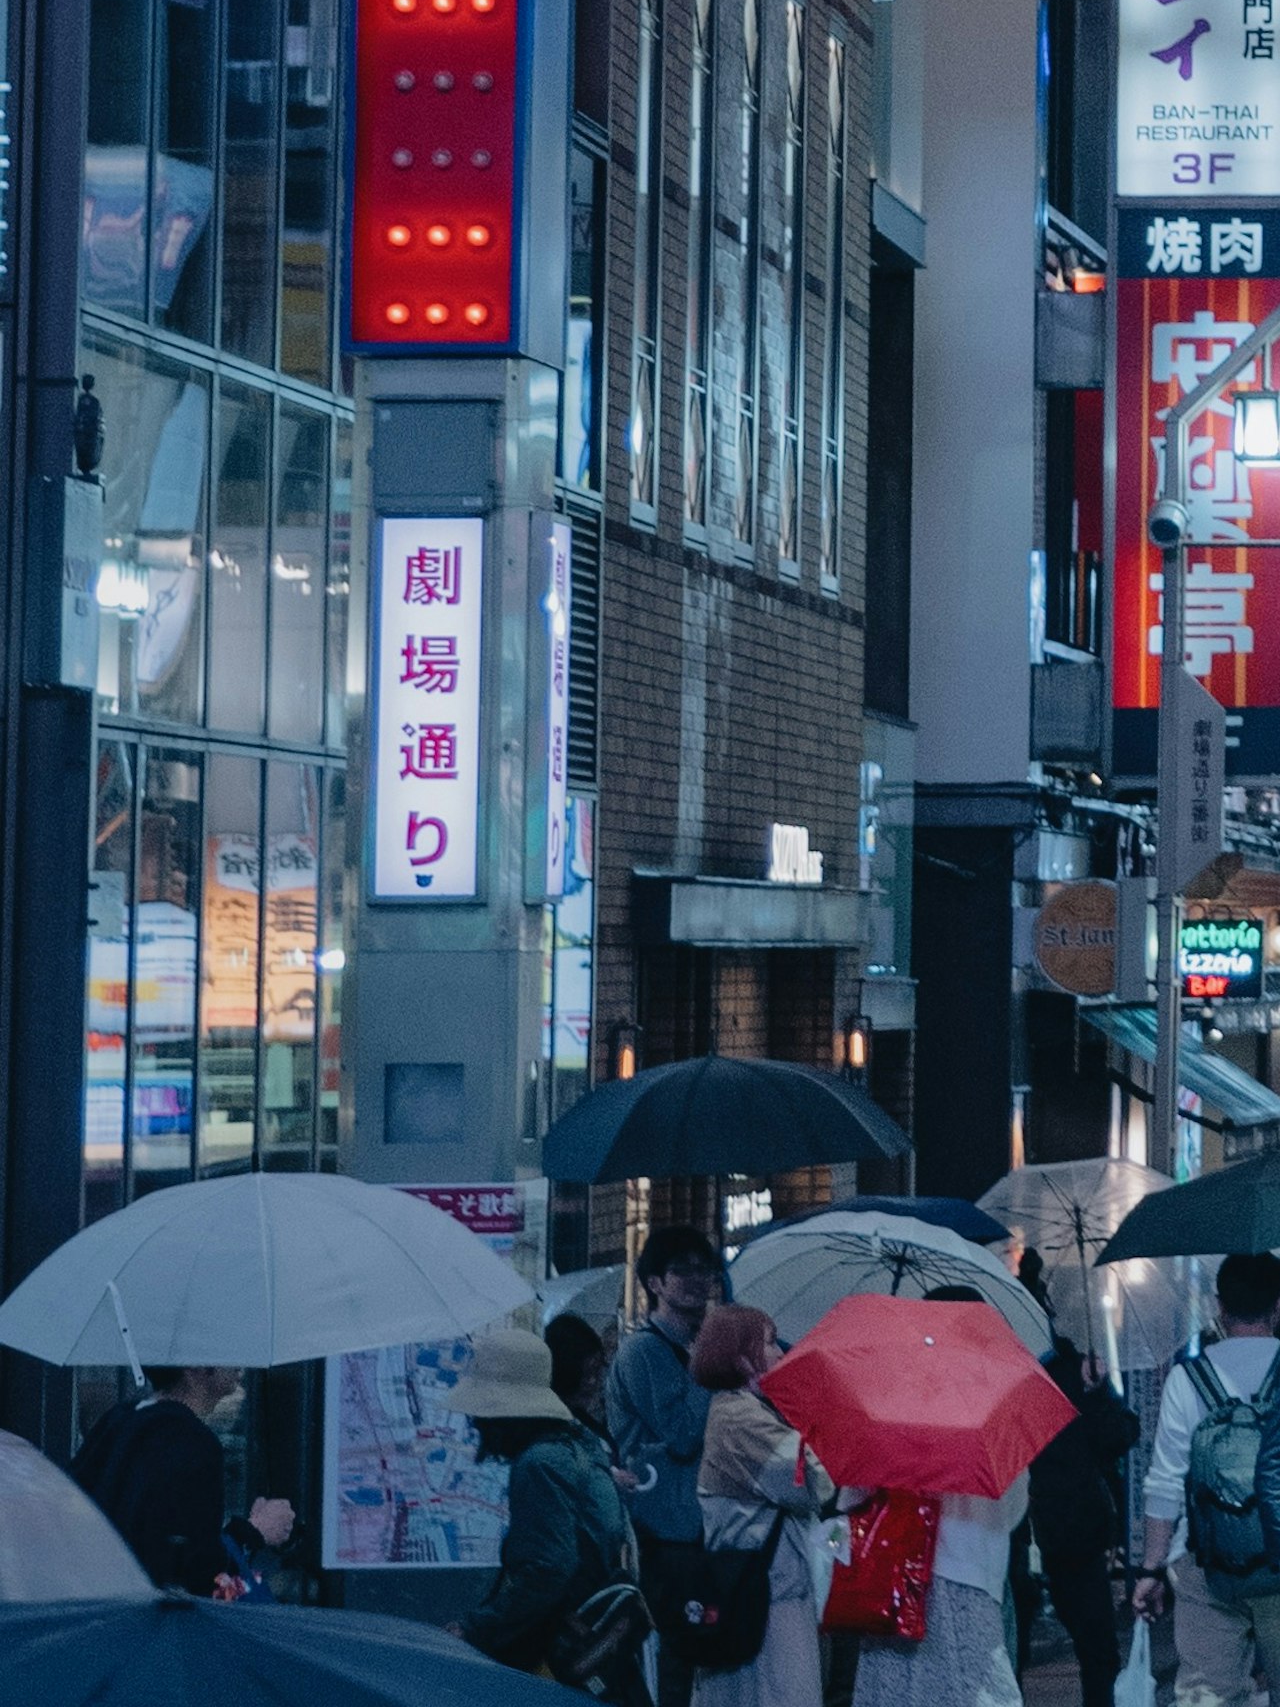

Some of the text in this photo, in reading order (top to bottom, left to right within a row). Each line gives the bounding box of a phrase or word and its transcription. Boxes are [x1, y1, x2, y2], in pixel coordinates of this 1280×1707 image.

[1152, 104, 1260, 121] BAN-THAI
[1136, 124, 1273, 142] RESTAURANT
[1172, 152, 1237, 185] 3F
[1146, 217, 1263, 273] 焼肉
[402, 545, 462, 867] 劇場通り
